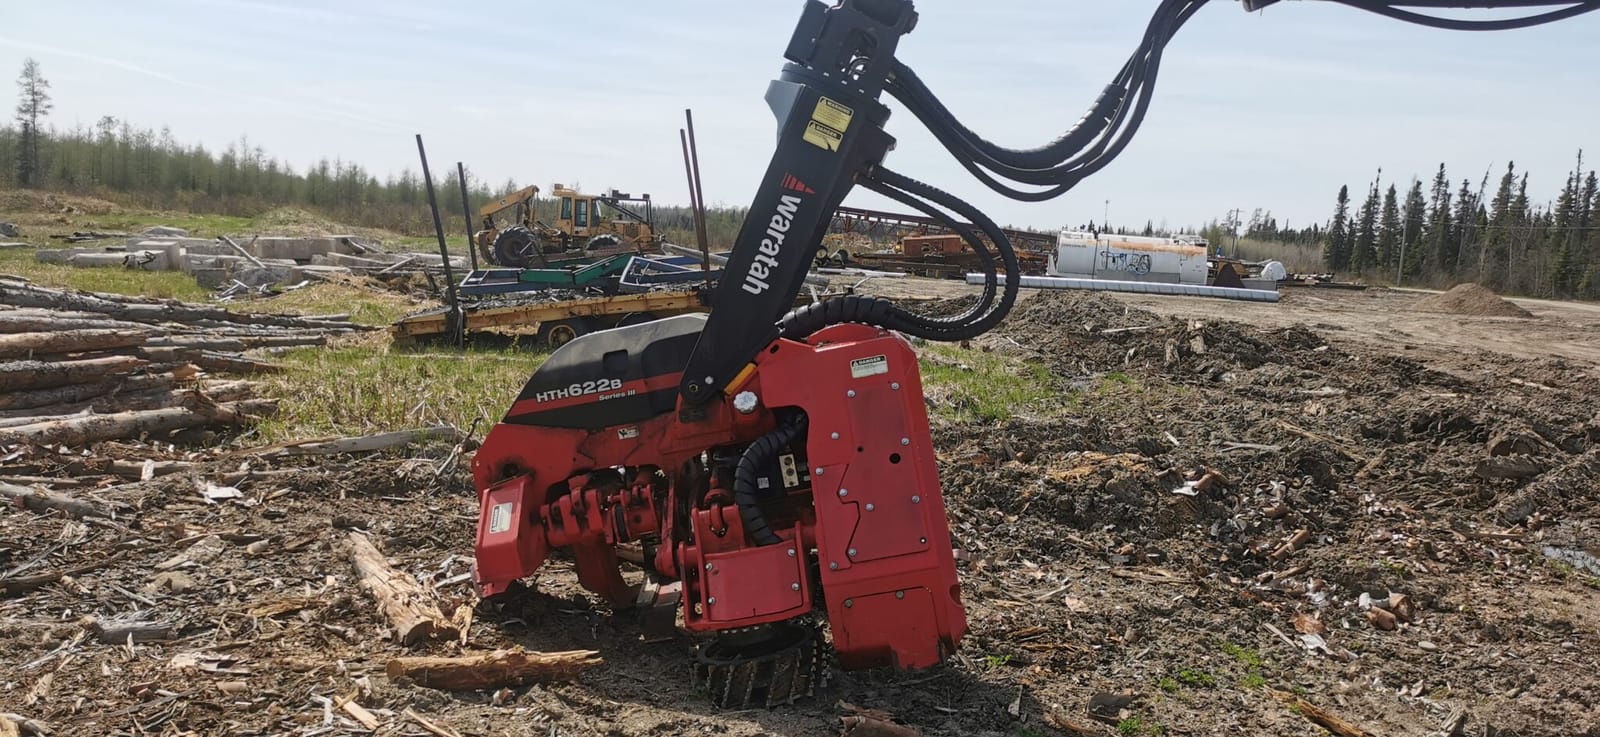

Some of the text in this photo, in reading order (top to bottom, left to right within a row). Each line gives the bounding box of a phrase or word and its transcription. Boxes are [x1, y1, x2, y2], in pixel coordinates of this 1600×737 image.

[742, 195, 801, 294] waratah
[536, 379, 622, 402] HTH622B
[599, 391, 626, 401] Series
